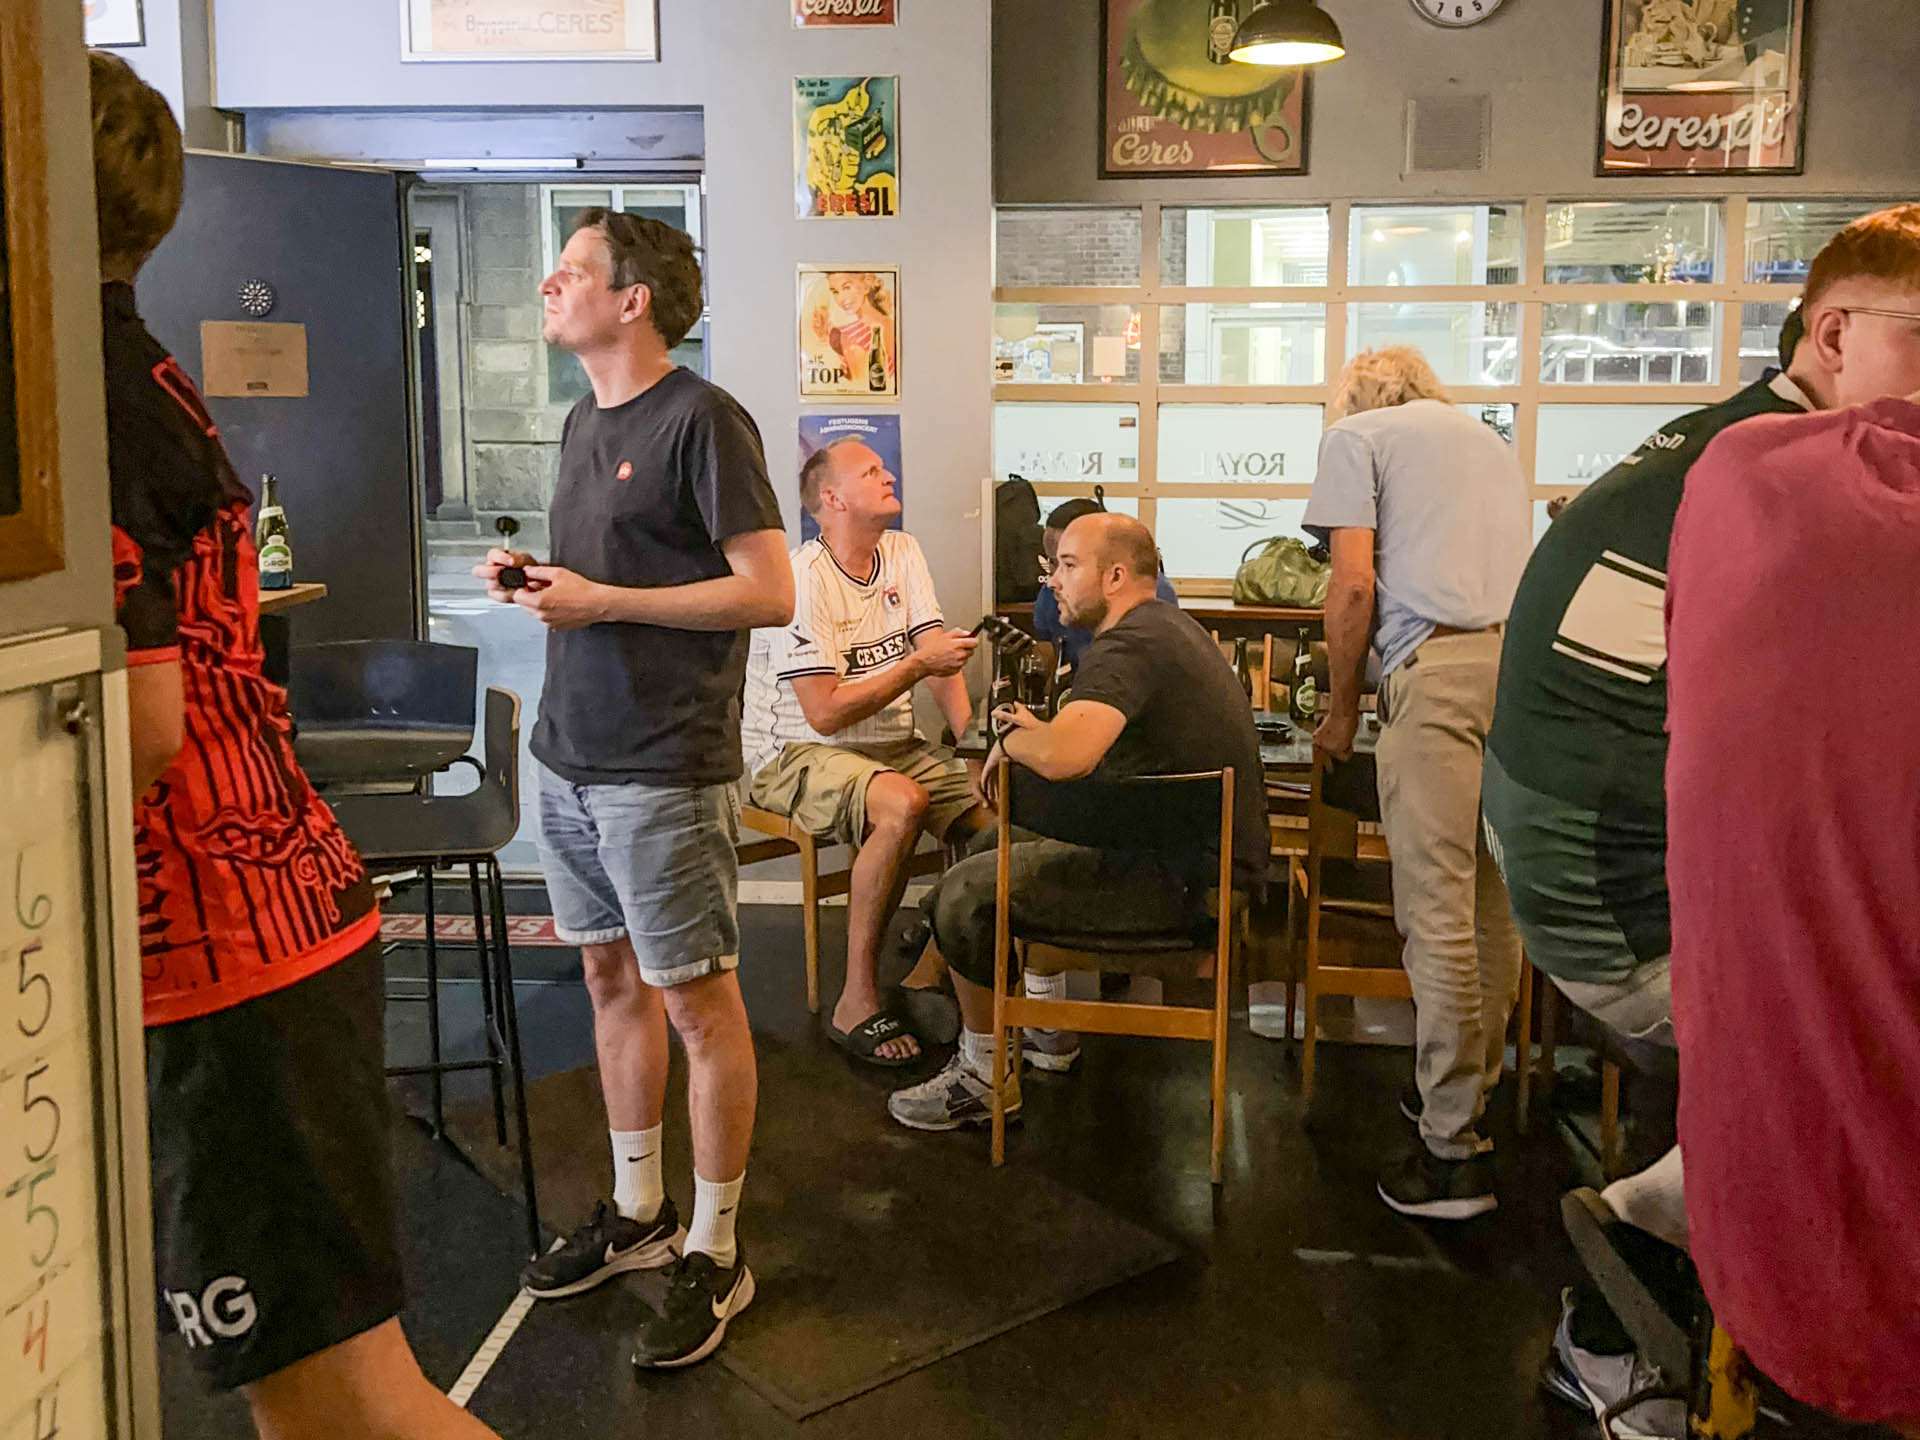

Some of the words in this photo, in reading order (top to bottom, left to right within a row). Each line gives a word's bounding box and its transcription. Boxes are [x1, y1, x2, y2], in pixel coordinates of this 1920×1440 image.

[1455, 6, 1463, 18] 6
[1472, 1, 1483, 12] 5
[537, 11, 614, 34] CERES
[1609, 103, 1720, 148] Ceres
[1112, 133, 1194, 166] Ceres
[809, 367, 846, 384] TOP
[856, 636, 905, 666] CERES
[17, 945, 52, 1037] 5
[23, 1064, 61, 1164] 5
[25, 1166, 60, 1268] 5
